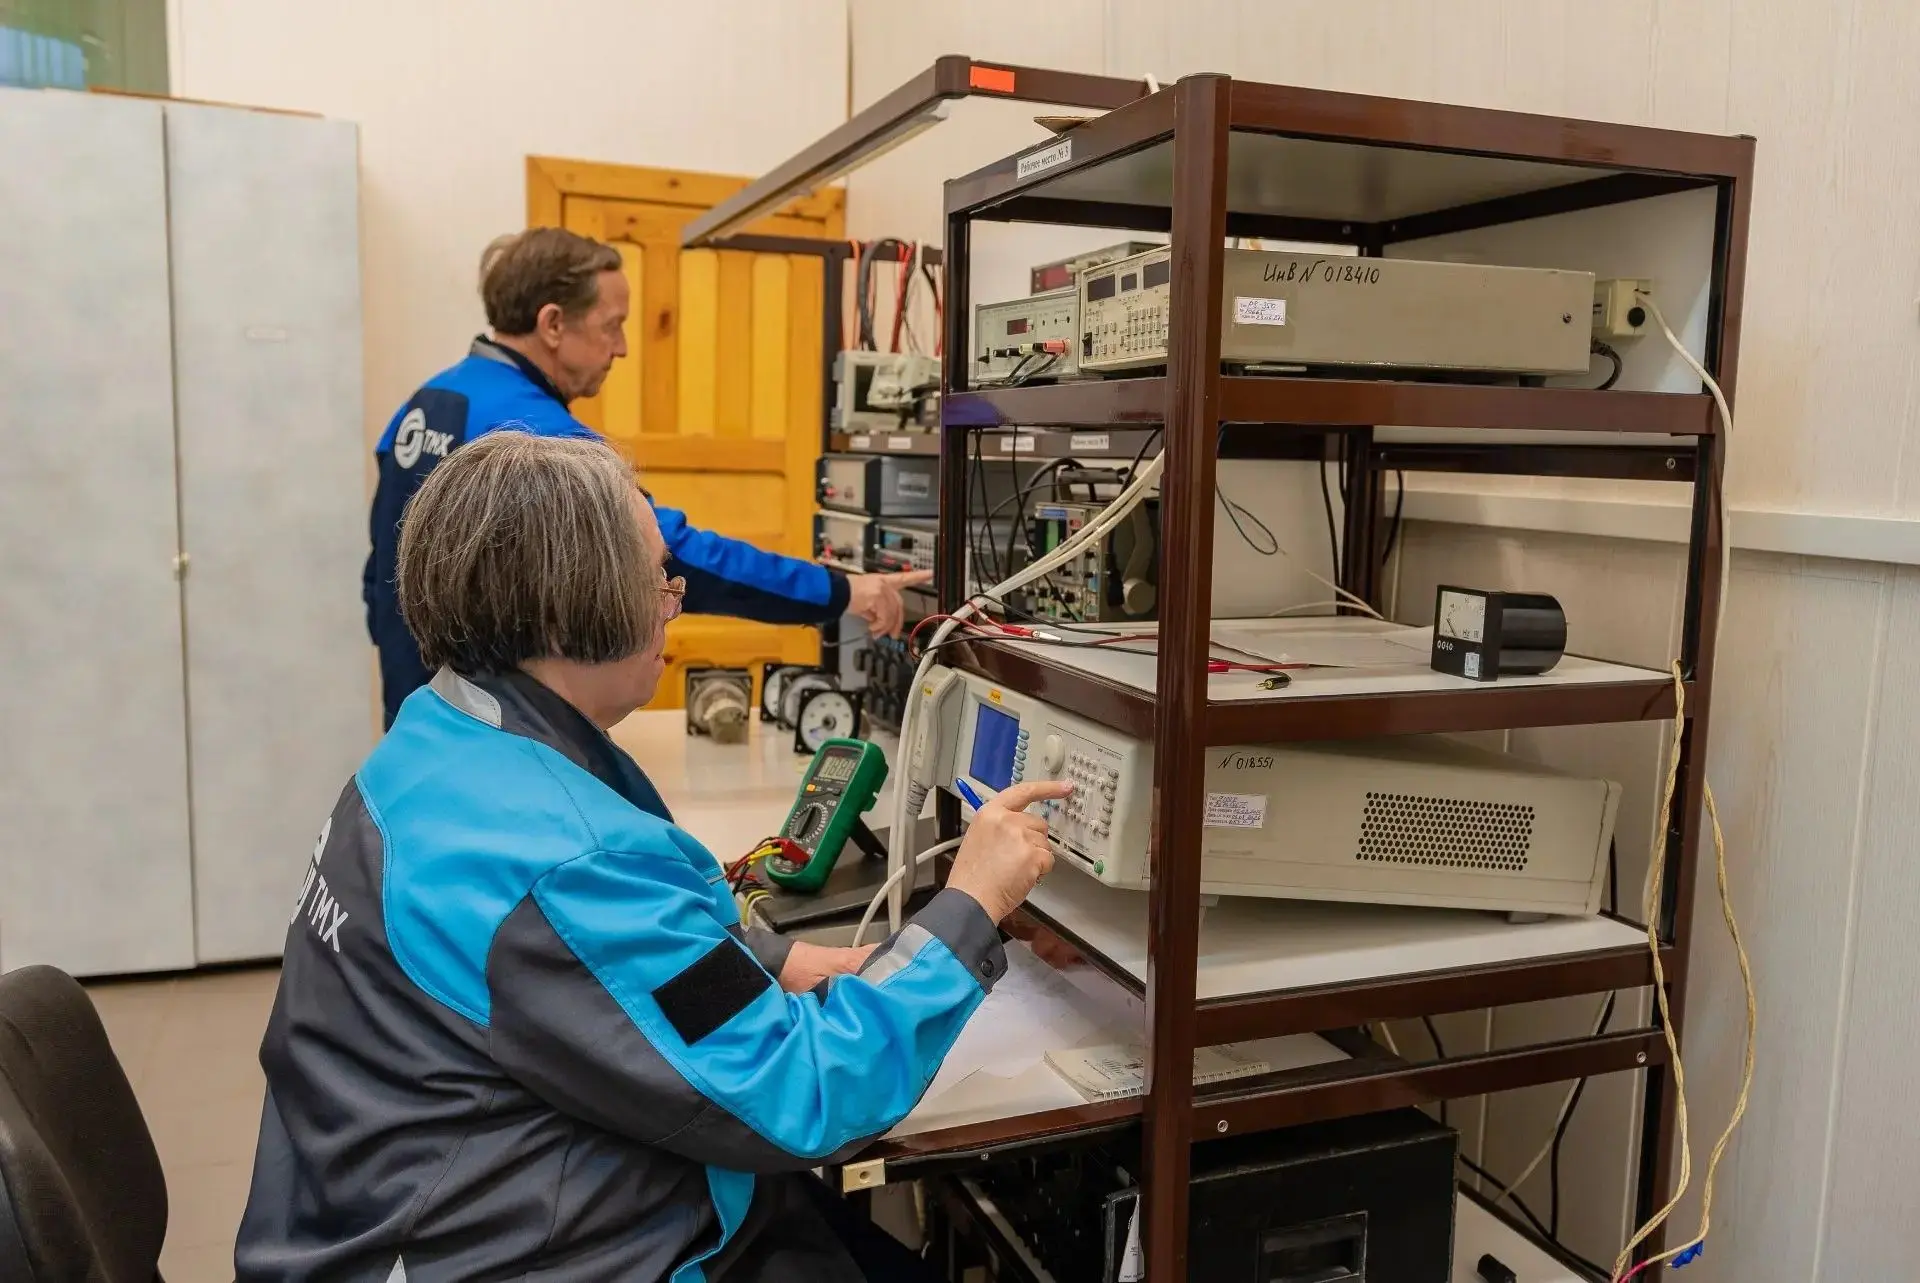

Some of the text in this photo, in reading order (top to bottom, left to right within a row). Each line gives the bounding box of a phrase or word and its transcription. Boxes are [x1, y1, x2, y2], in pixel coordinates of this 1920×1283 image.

[1041, 154, 1057, 165] место
[1324, 266, 1380, 284] 018410
[1236, 756, 1274, 770] 018551
[308, 874, 349, 953] ТМХ
